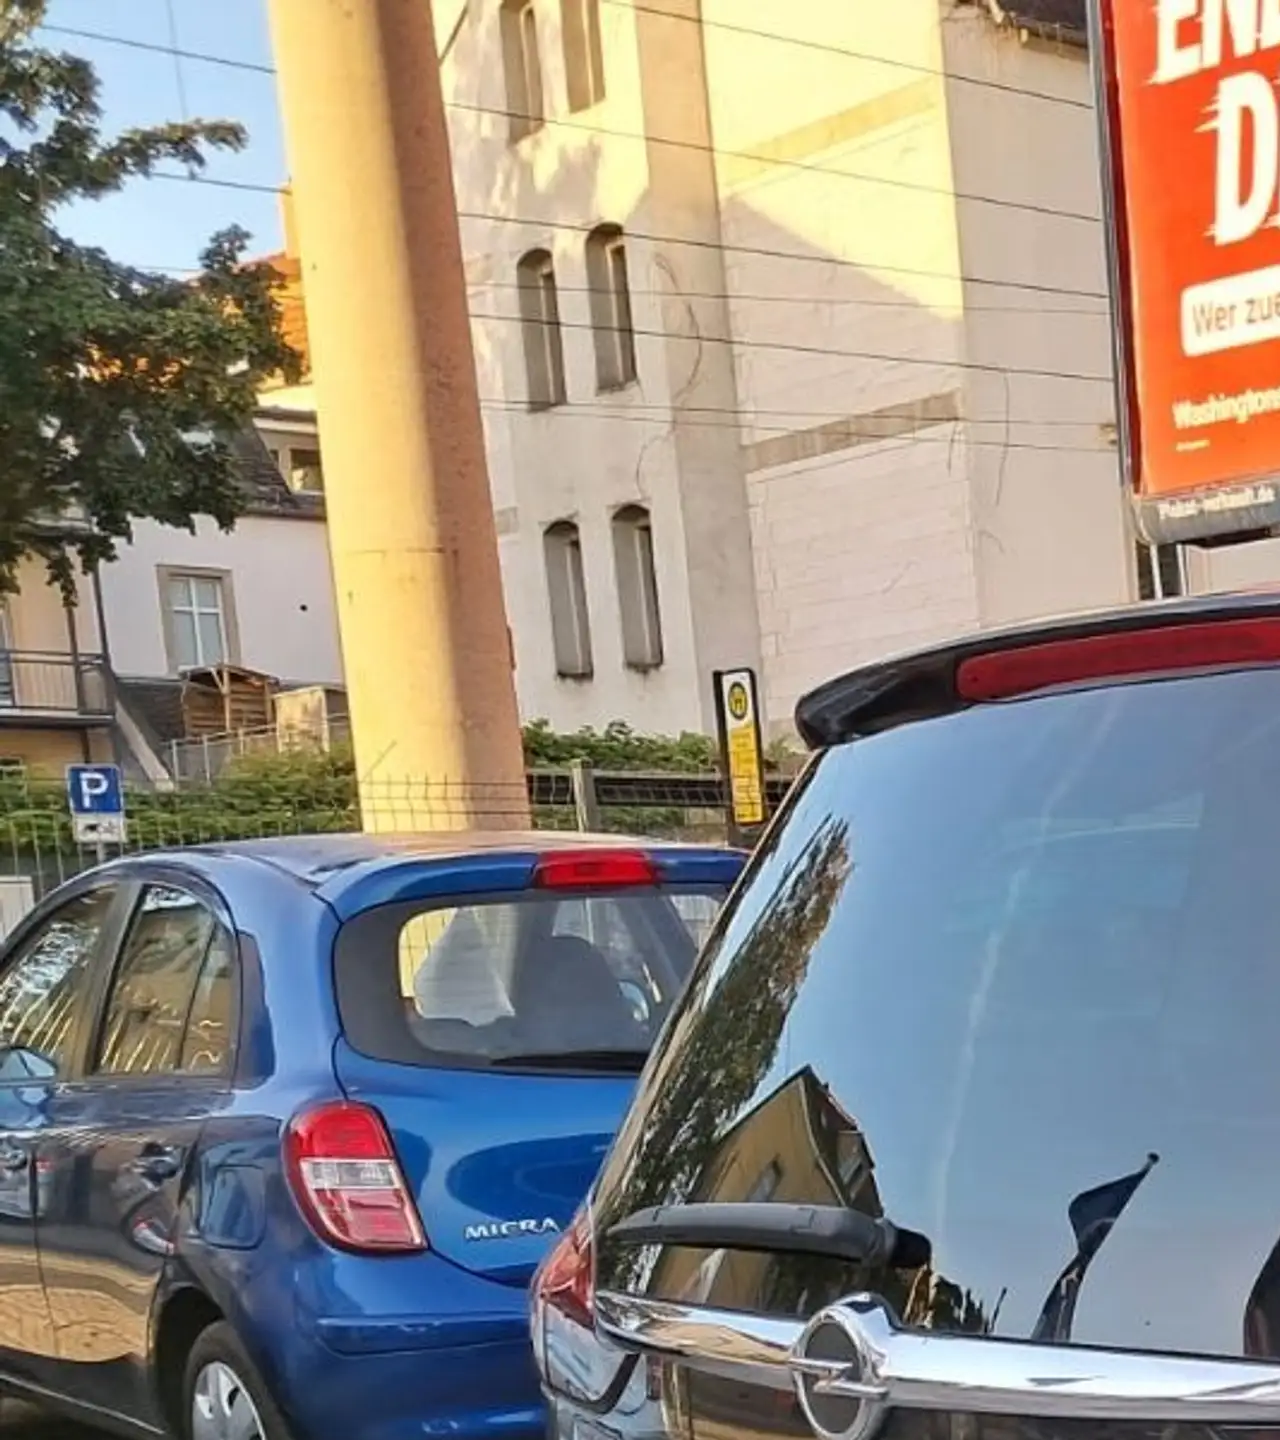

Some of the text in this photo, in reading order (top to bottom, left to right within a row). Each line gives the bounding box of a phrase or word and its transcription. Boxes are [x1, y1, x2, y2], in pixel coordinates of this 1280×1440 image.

[1191, 302, 1238, 337] Wer
[79, 772, 108, 808] P
[464, 1217, 561, 1240] MICRA
